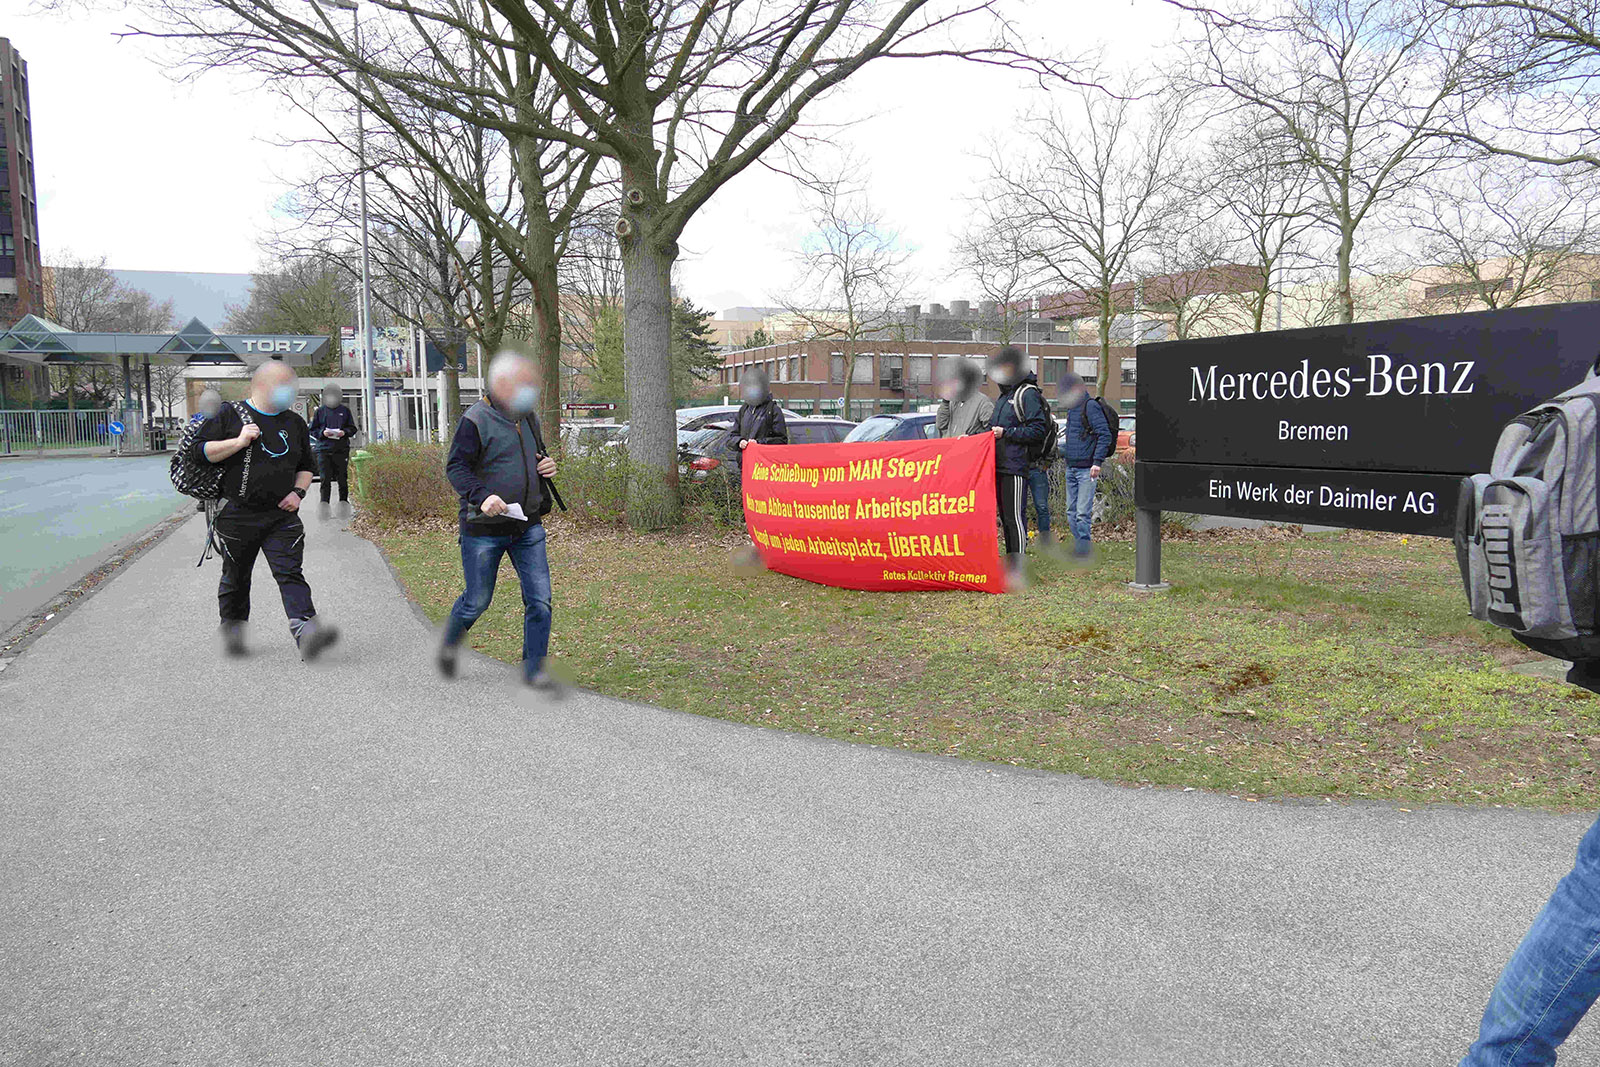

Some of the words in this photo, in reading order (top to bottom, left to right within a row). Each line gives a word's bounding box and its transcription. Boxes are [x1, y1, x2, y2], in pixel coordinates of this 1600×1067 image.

[1189, 354, 1475, 402] Mercedes-Benz
[1278, 420, 1348, 441] Bremen
[751, 462, 770, 481] Keine
[769, 463, 820, 489] Schließung
[822, 467, 846, 483] von
[847, 458, 884, 483] MAN
[886, 453, 943, 483] Steyr!
[768, 497, 793, 518] Abbau
[793, 498, 851, 521] tausender
[855, 489, 976, 521] Arbeitsplätze!
[1209, 479, 1232, 499] Ein
[1236, 480, 1279, 503] Werk
[1284, 484, 1314, 505] der
[1319, 485, 1397, 512] Daimler
[1402, 490, 1435, 515] AG
[780, 532, 807, 555] jeden
[807, 535, 888, 561] Arbeitsplatz,
[887, 531, 965, 558] ÜBERALL
[883, 569, 906, 581] Rotes
[907, 570, 946, 582] Kollektiv
[948, 570, 988, 584] Bremen
